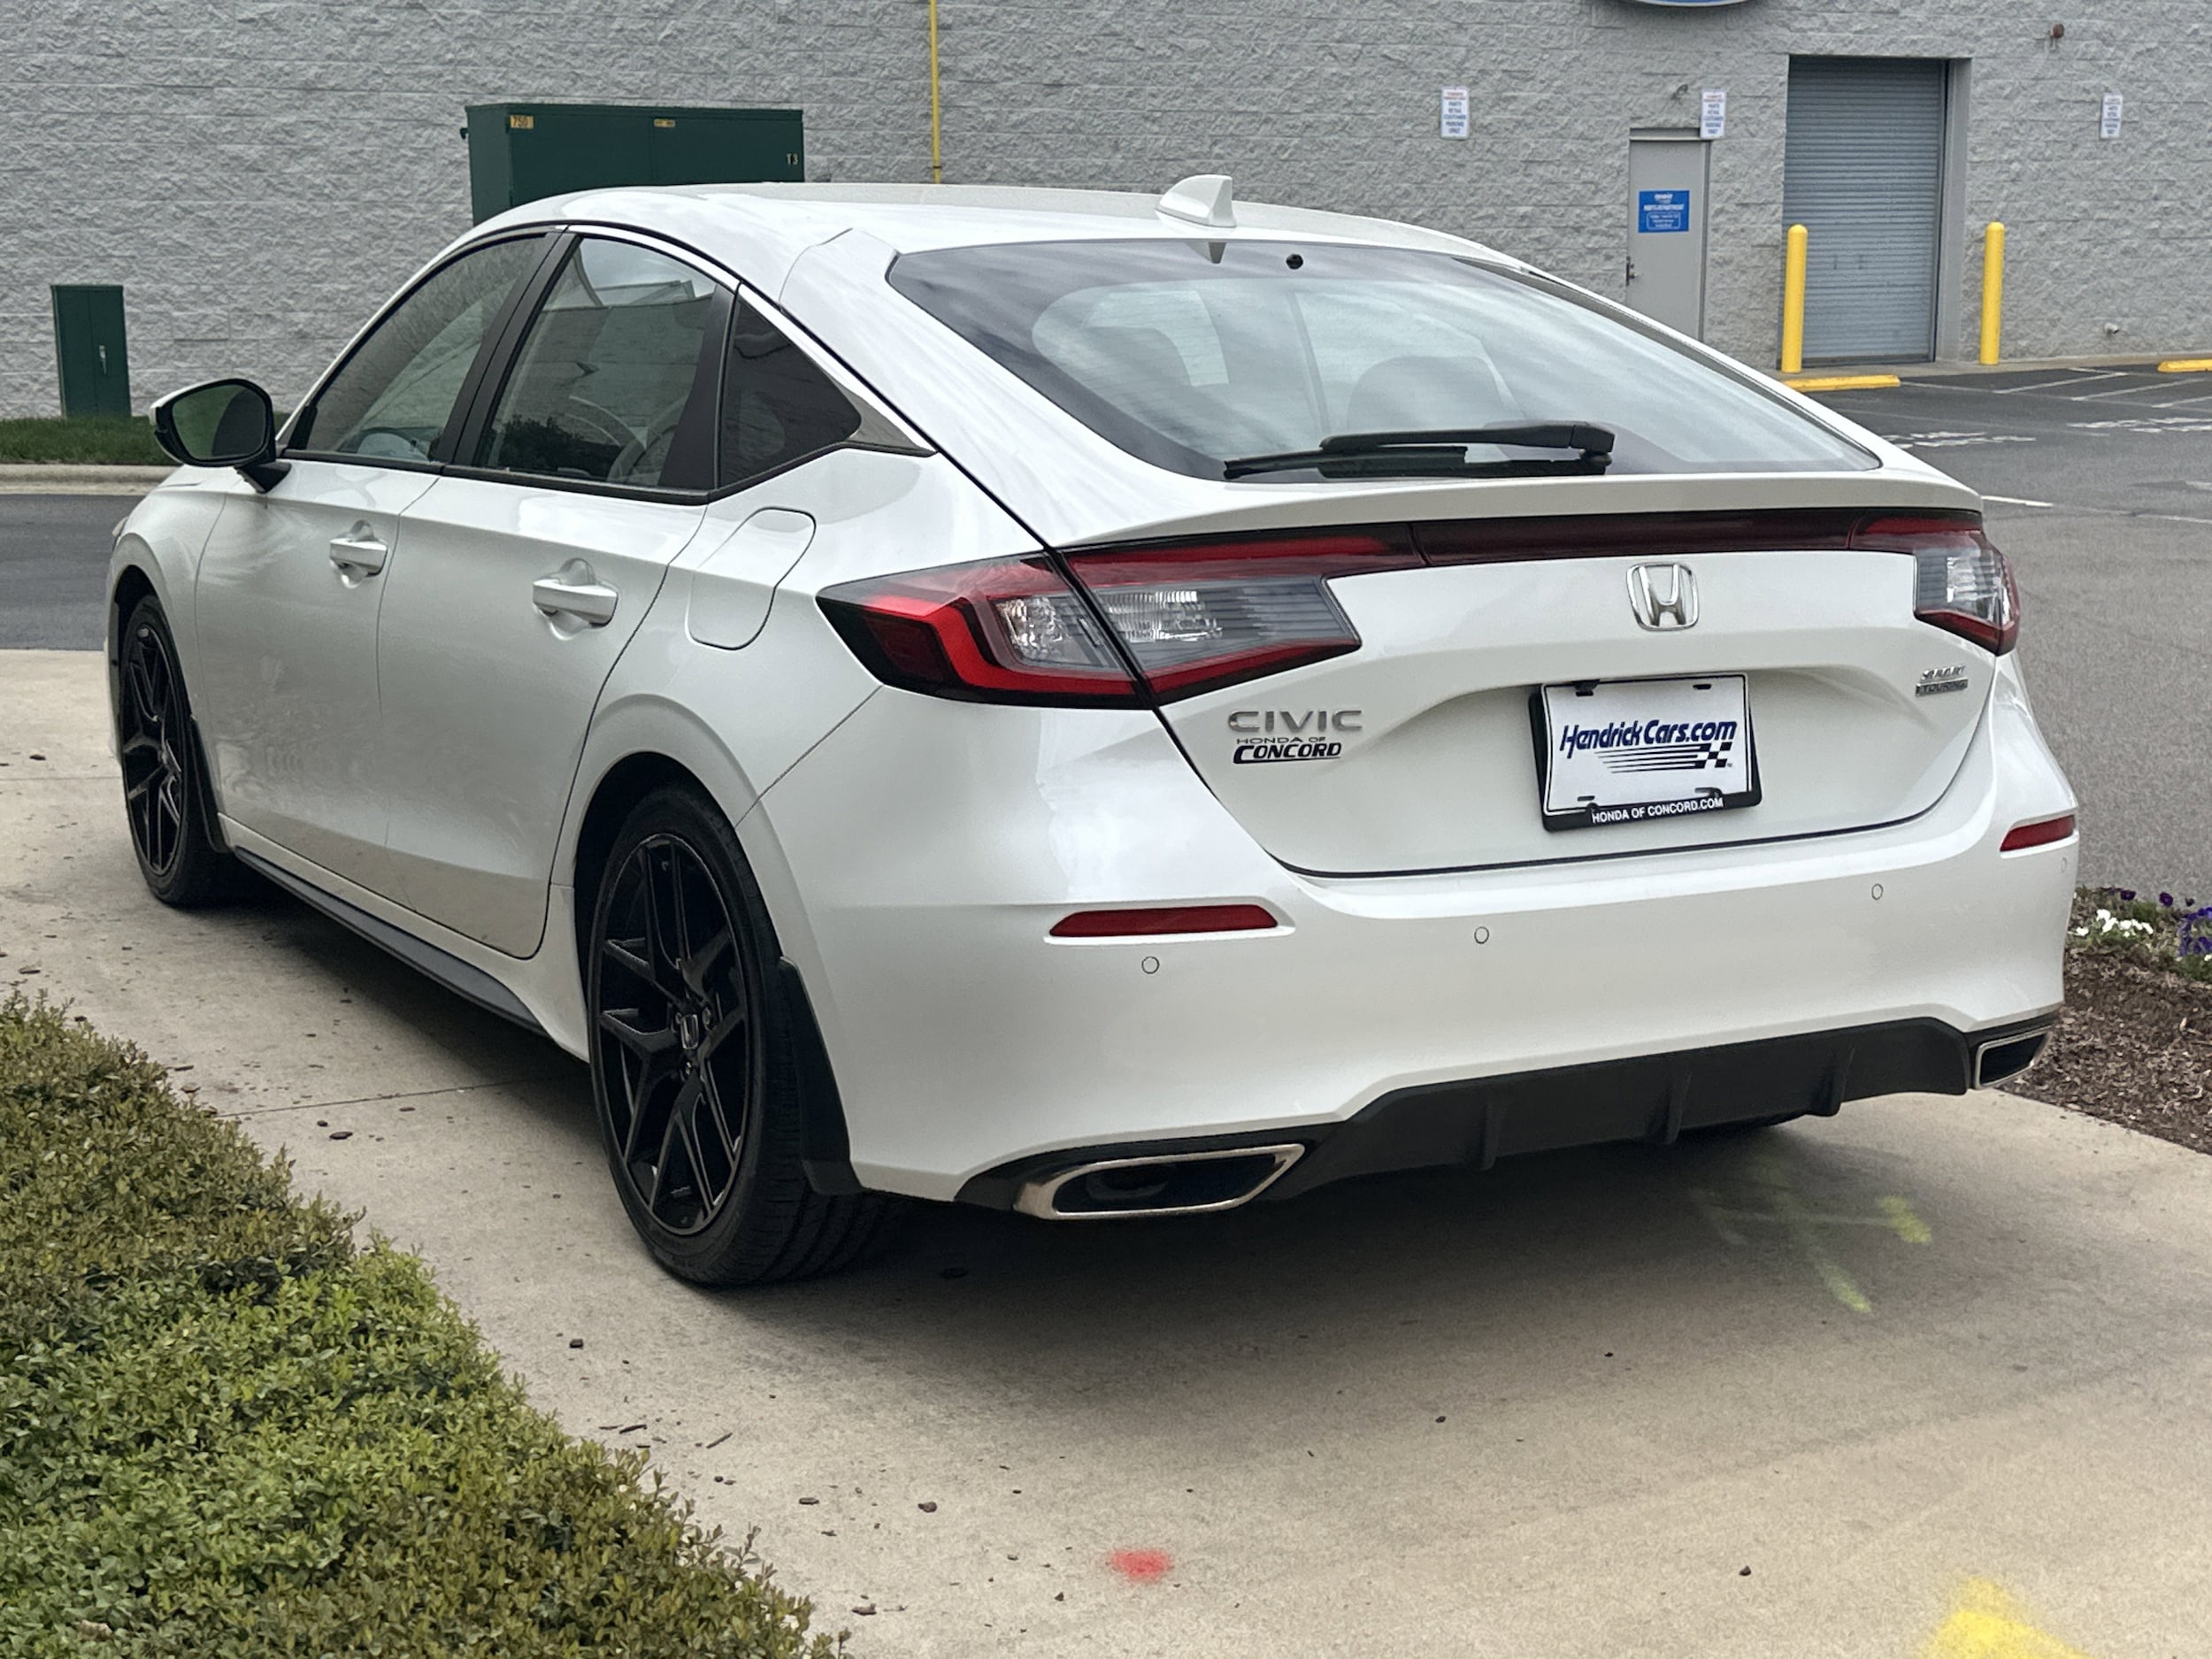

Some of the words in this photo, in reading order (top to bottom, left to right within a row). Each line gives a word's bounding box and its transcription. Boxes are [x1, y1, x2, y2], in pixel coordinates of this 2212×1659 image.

[1228, 710, 1363, 733] CIVIC
[1237, 736, 1303, 745] HONDA
[1233, 742, 1342, 764] CONCORD
[1593, 809, 1630, 824] HONDA
[1632, 806, 1646, 818] OF
